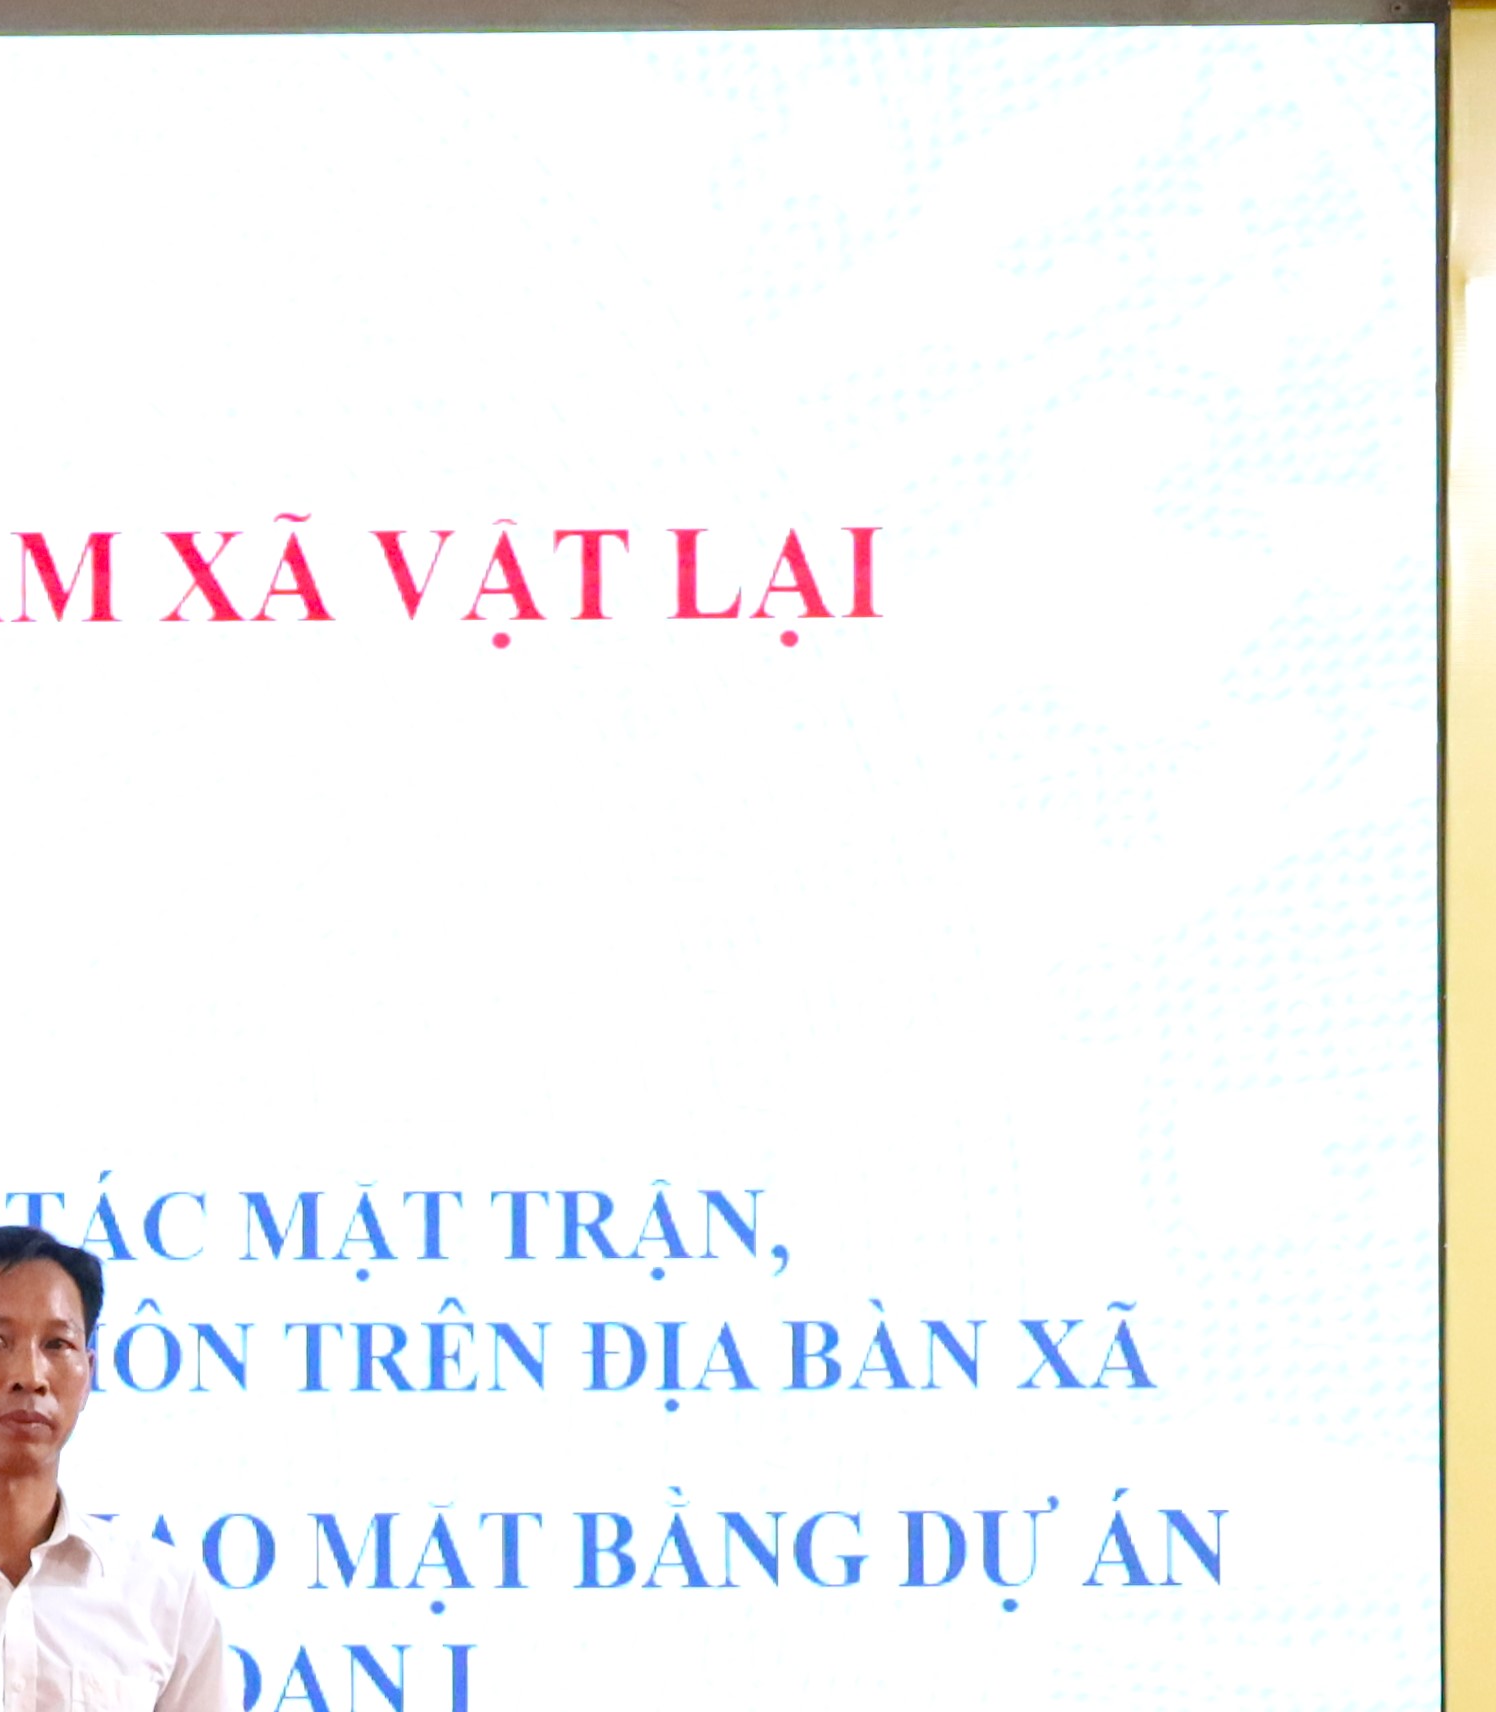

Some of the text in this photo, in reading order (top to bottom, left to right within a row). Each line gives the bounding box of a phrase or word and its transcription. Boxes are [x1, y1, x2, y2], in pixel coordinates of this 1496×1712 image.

[159, 511, 337, 623] XÃ
[369, 517, 634, 650] VẬT
[668, 525, 882, 648] LẠI
[6, 1170, 204, 1261] TÁC
[243, 1180, 462, 1282] MẶT
[491, 1179, 789, 1281] TRẬN,
[285, 1297, 547, 1392] TRÊN
[584, 1321, 755, 1412] ĐỊA
[788, 1299, 984, 1389] BÀN
[1020, 1301, 1156, 1389] XÃ
[309, 1502, 543, 1614] MẶT
[575, 1486, 866, 1589] BẰNG
[901, 1496, 1059, 1613] DỰ
[1084, 1487, 1226, 1586] ÁN
